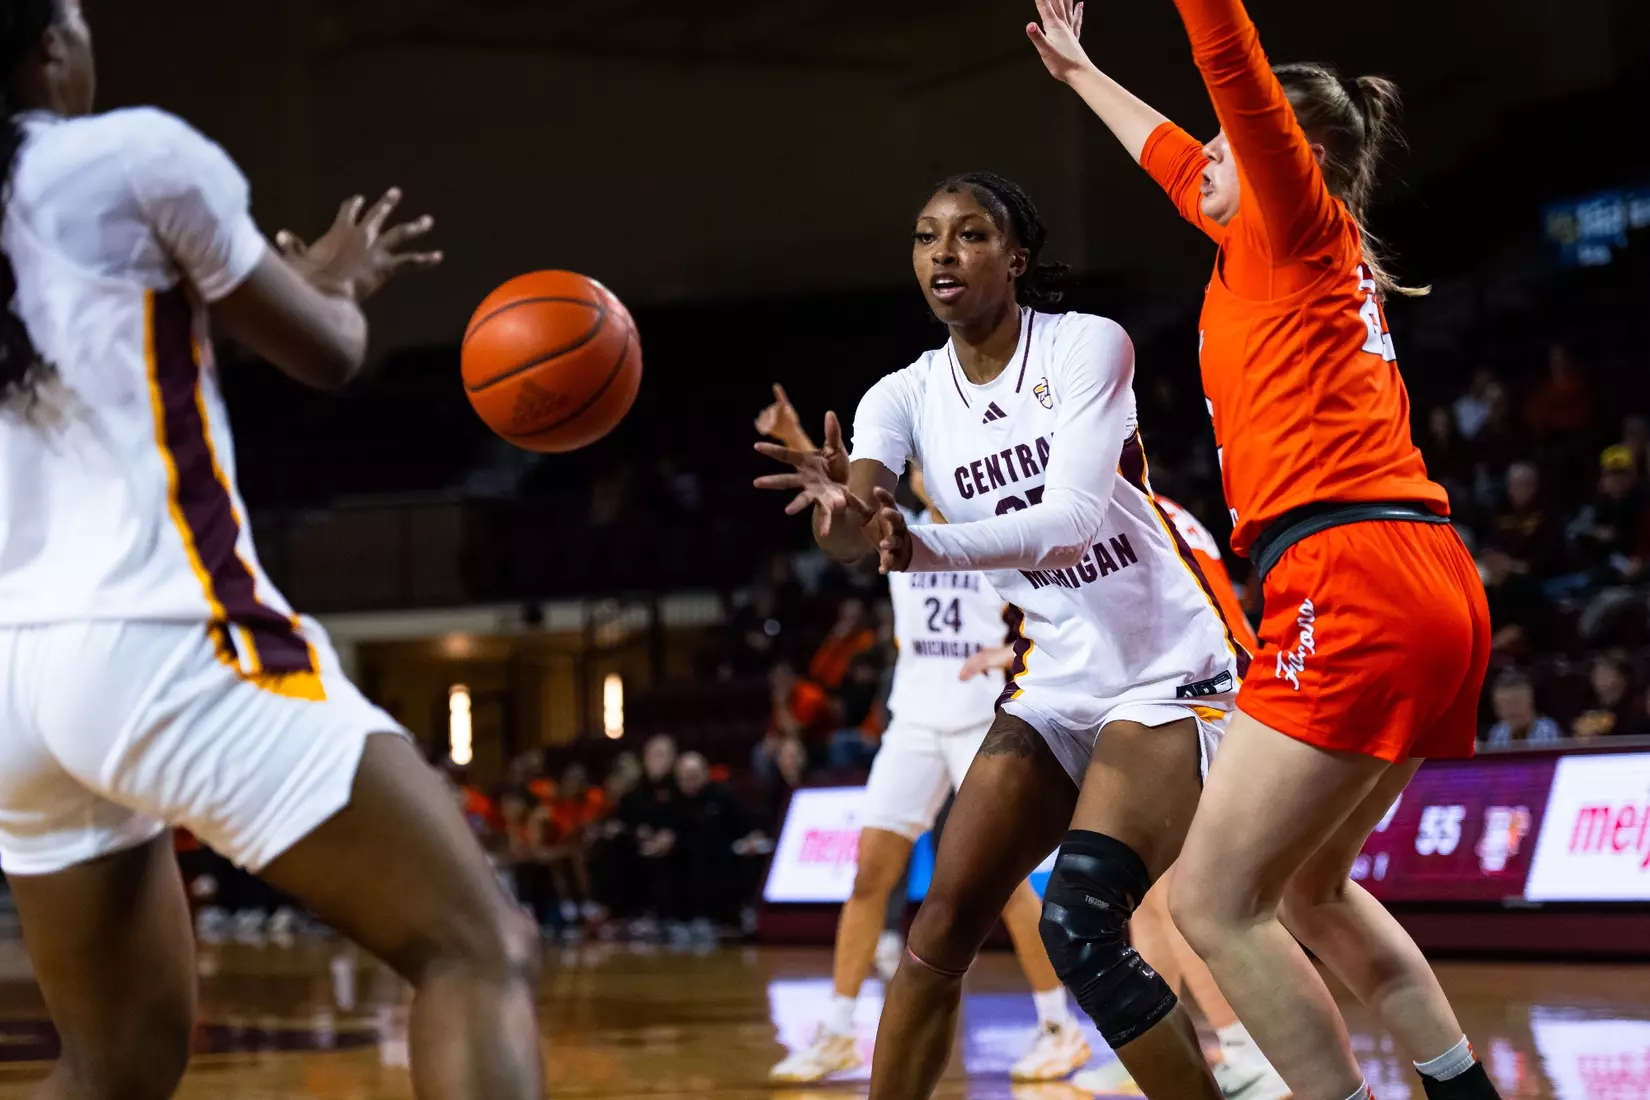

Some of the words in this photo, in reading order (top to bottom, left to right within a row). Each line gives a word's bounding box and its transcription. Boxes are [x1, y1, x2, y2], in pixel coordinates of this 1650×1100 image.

[954, 432, 1054, 500] CENTRA
[924, 597, 963, 634] 24
[1415, 805, 1466, 855] 55
